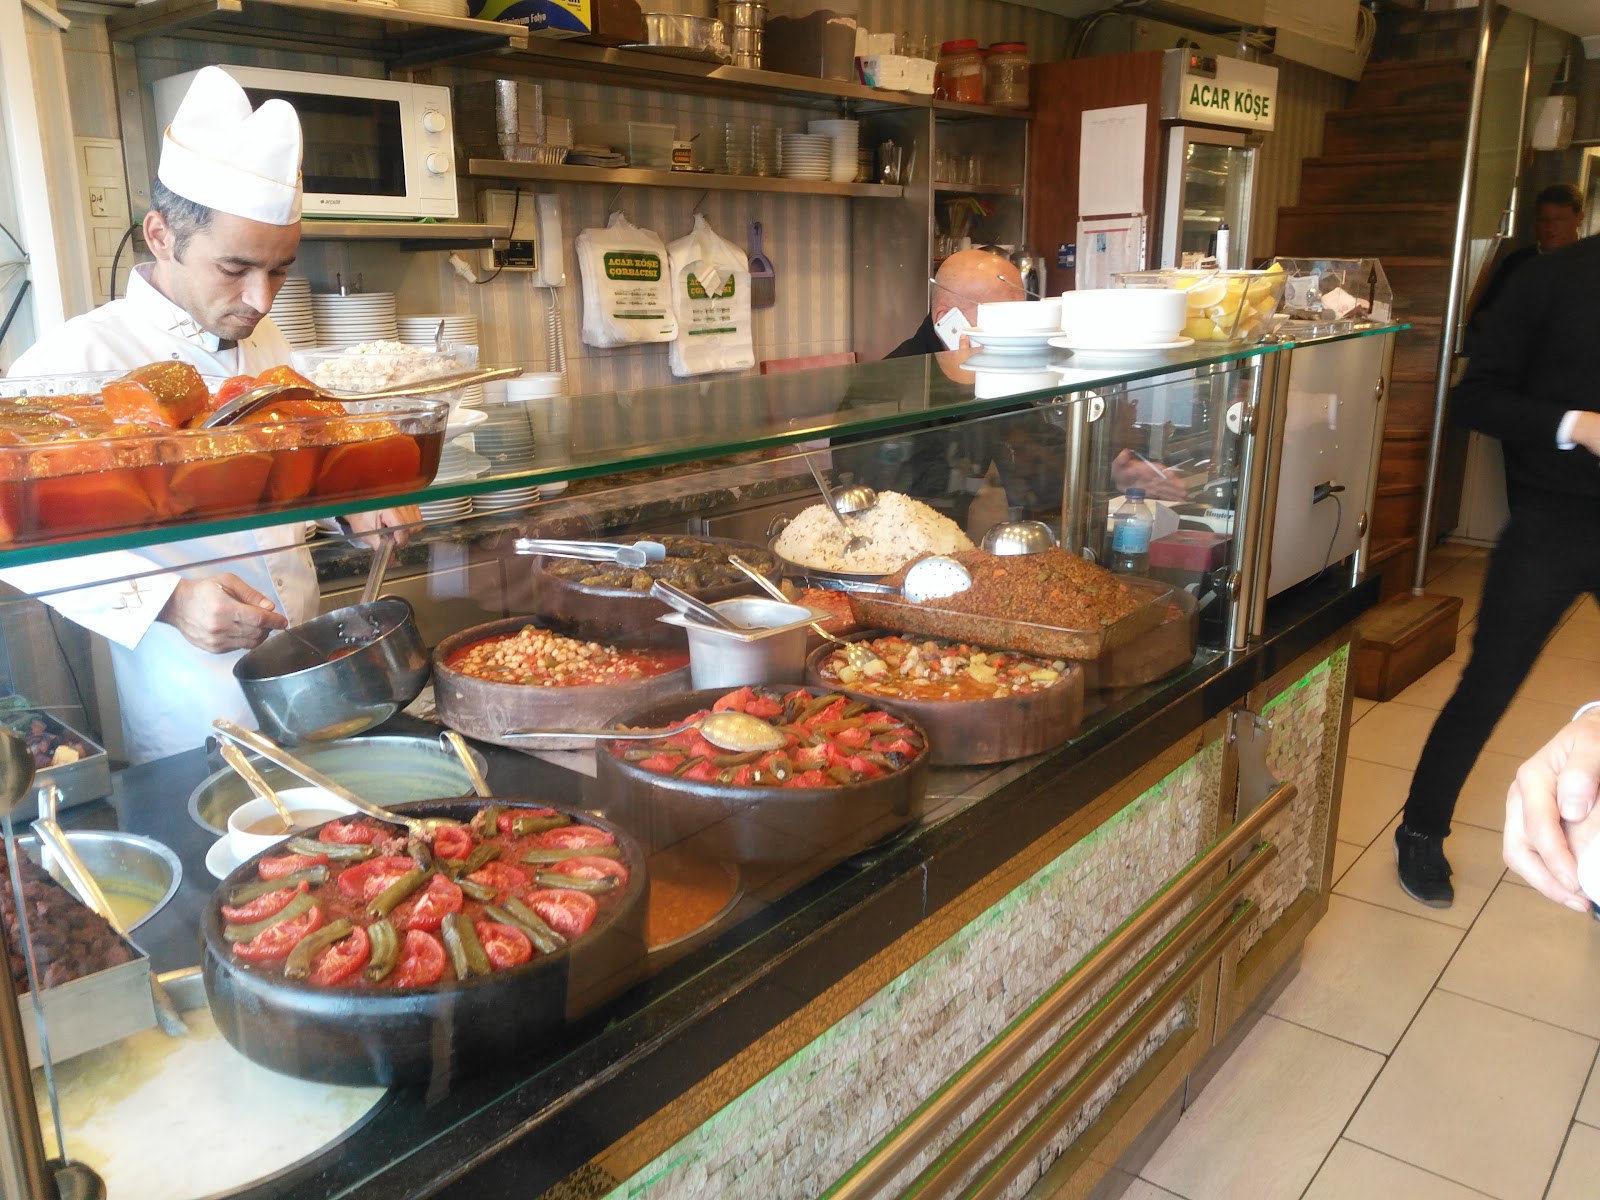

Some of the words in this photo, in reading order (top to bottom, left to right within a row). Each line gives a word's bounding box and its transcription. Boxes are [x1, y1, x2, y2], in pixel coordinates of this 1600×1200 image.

[1189, 83, 1230, 111] ACAR
[1234, 88, 1269, 120] KÖŞE
[608, 258, 633, 267] ACAR
[634, 258, 658, 270] KÖŞE
[609, 267, 657, 278] ÇORBACISI
